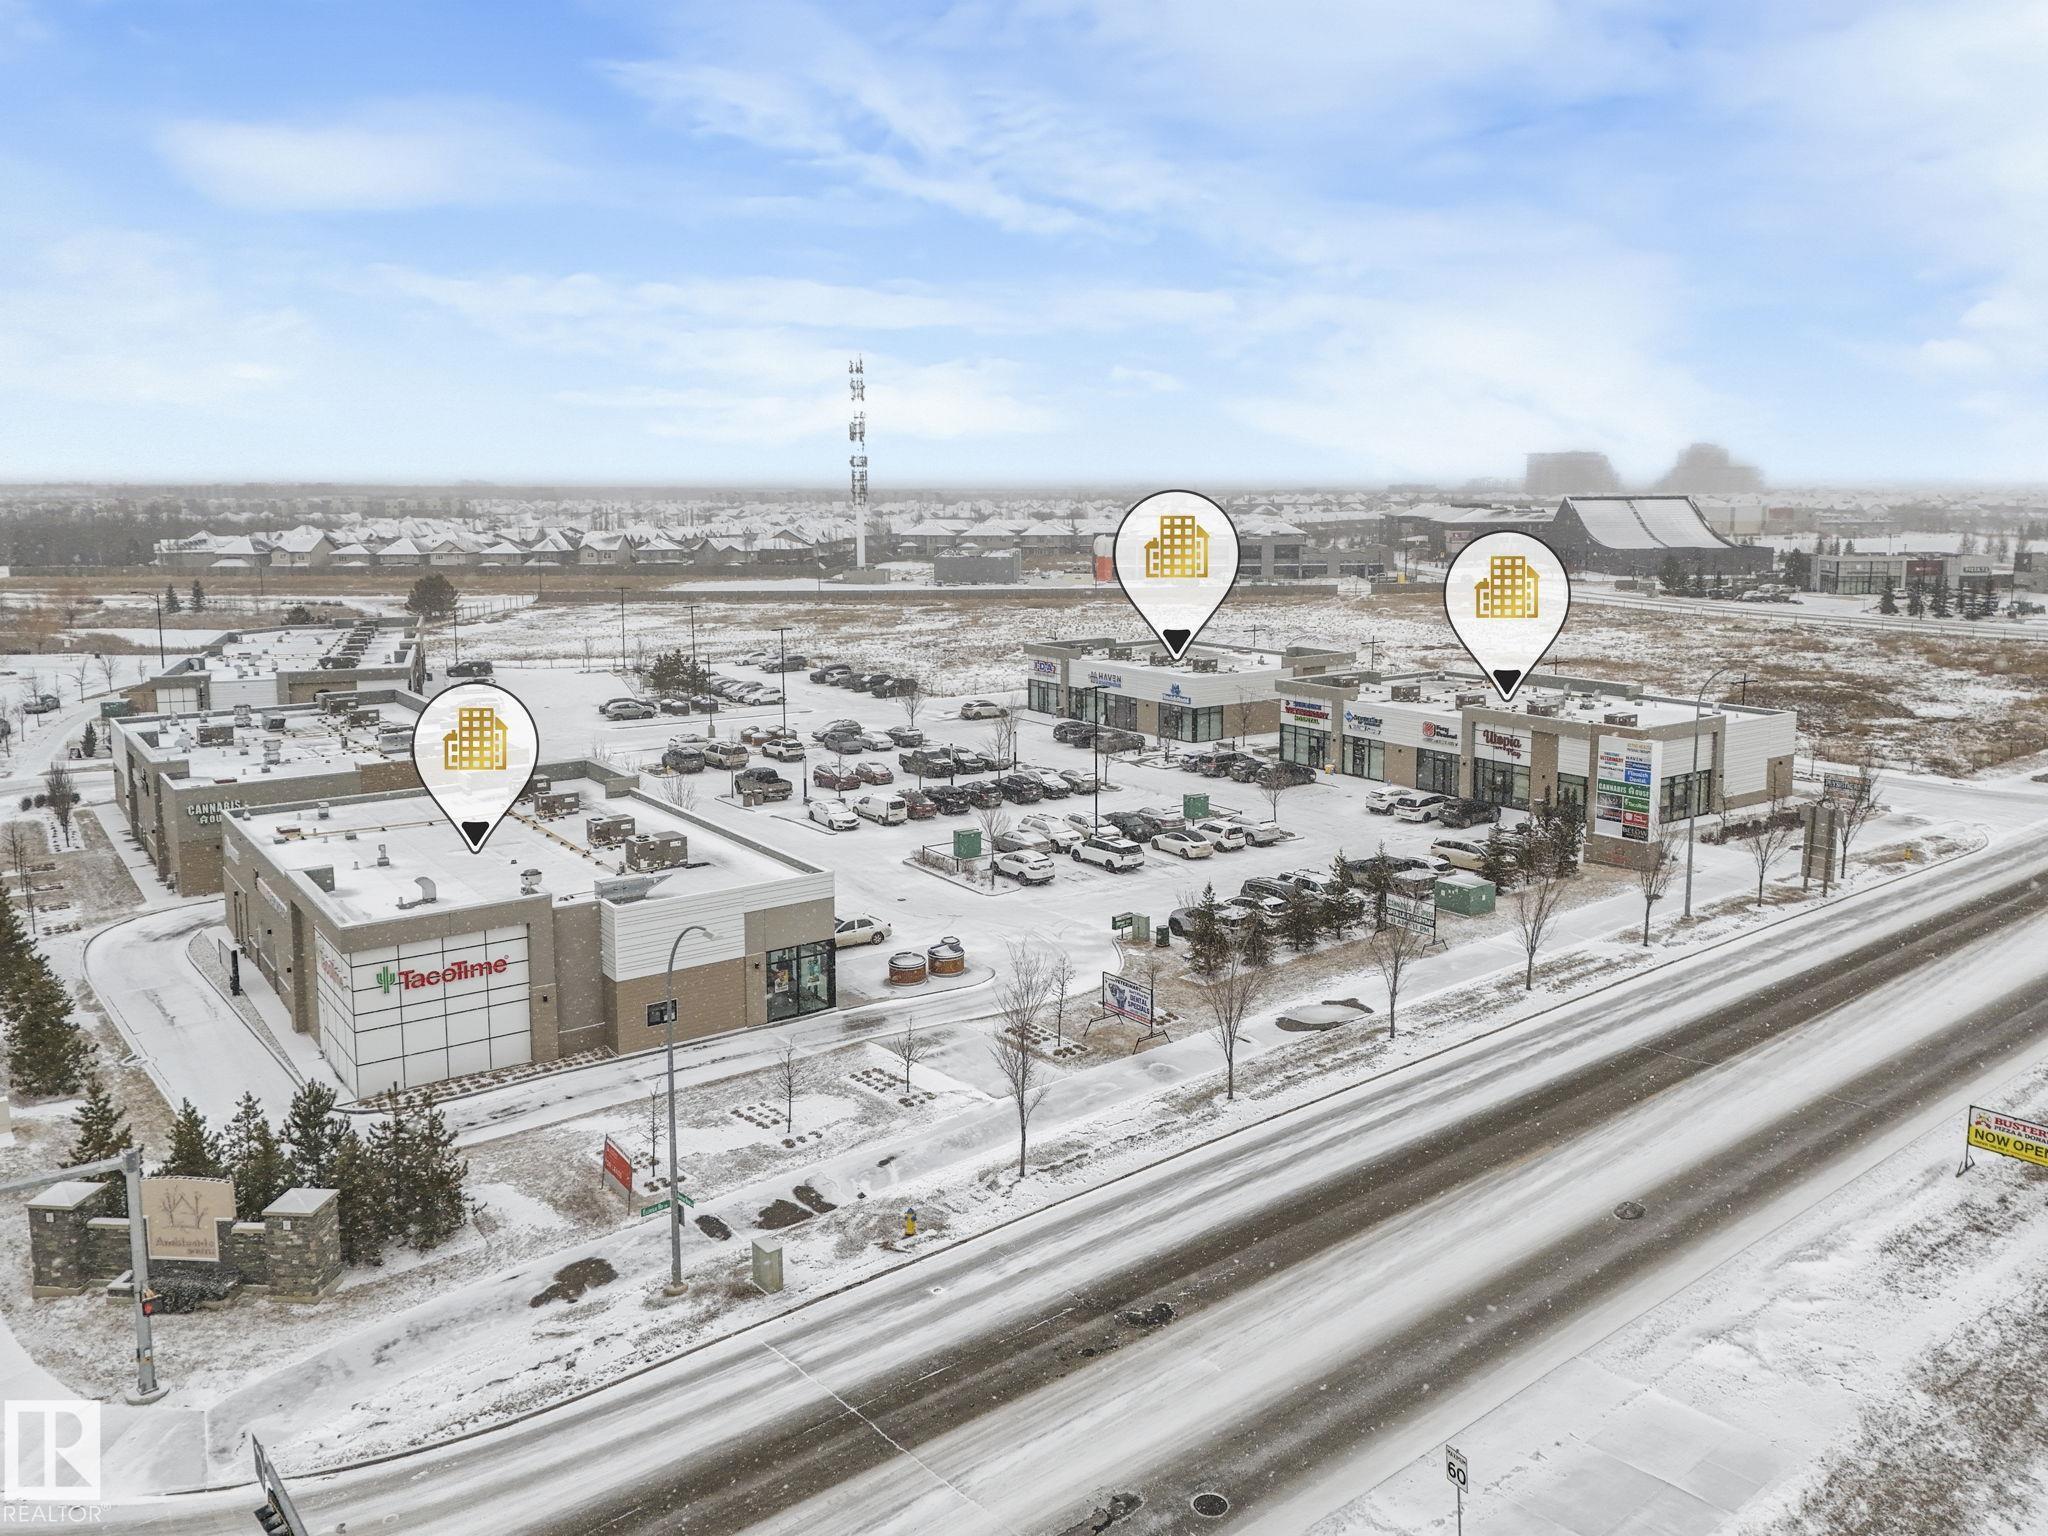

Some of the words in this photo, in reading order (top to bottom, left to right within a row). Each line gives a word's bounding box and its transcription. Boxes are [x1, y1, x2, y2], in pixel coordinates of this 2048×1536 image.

[1098, 671, 1122, 683] HAVEN
[1482, 729, 1522, 748] Utopia
[1598, 782, 1627, 794] CANNABIS
[187, 800, 241, 816] CANNABIS
[398, 957, 507, 990] TacoTime
[1115, 979, 1142, 992] VETERINARY
[1128, 1000, 1150, 1015] SPECIALS
[1129, 994, 1148, 1007] DENTAL
[1974, 1128, 2010, 1147] NOW
[1994, 1125, 2016, 1136] PIZZA
[1447, 1461, 1466, 1486] 60
